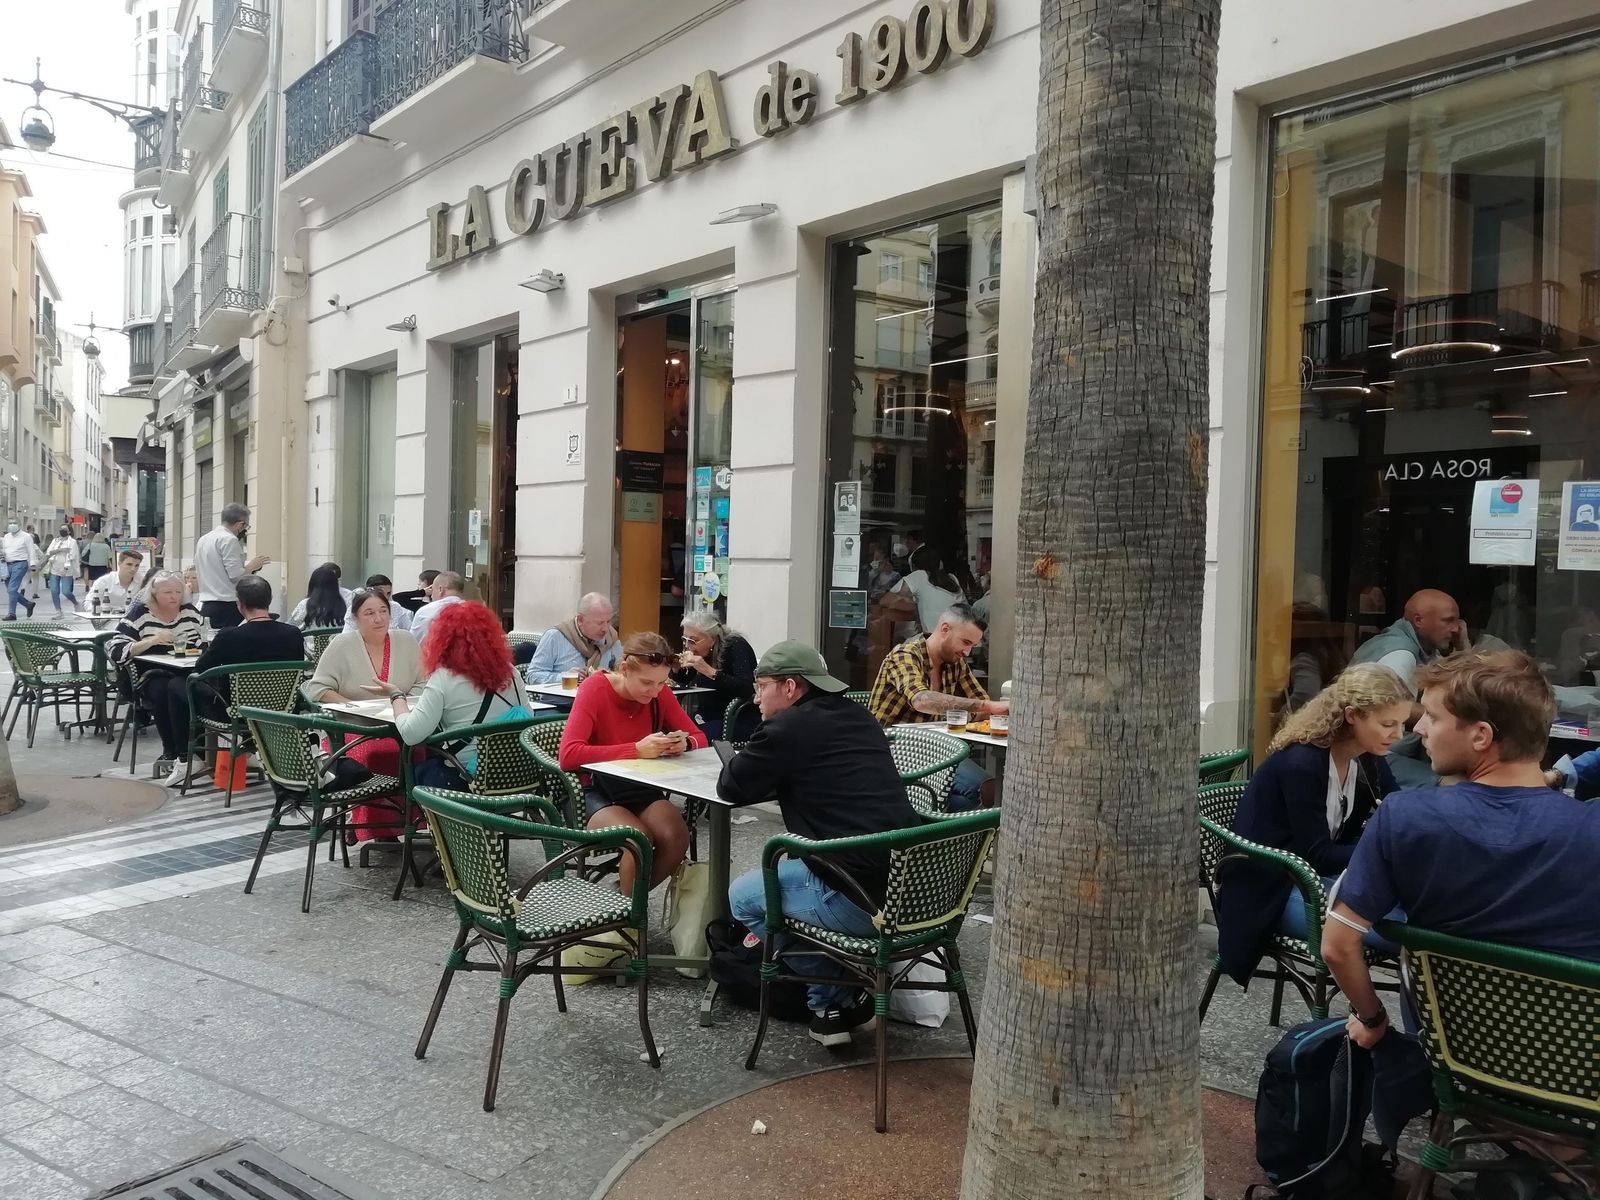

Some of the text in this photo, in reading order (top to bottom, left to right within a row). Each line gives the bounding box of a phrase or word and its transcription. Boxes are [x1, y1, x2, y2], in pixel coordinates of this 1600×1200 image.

[425, 0, 997, 271] LA CUEVA de 1900
